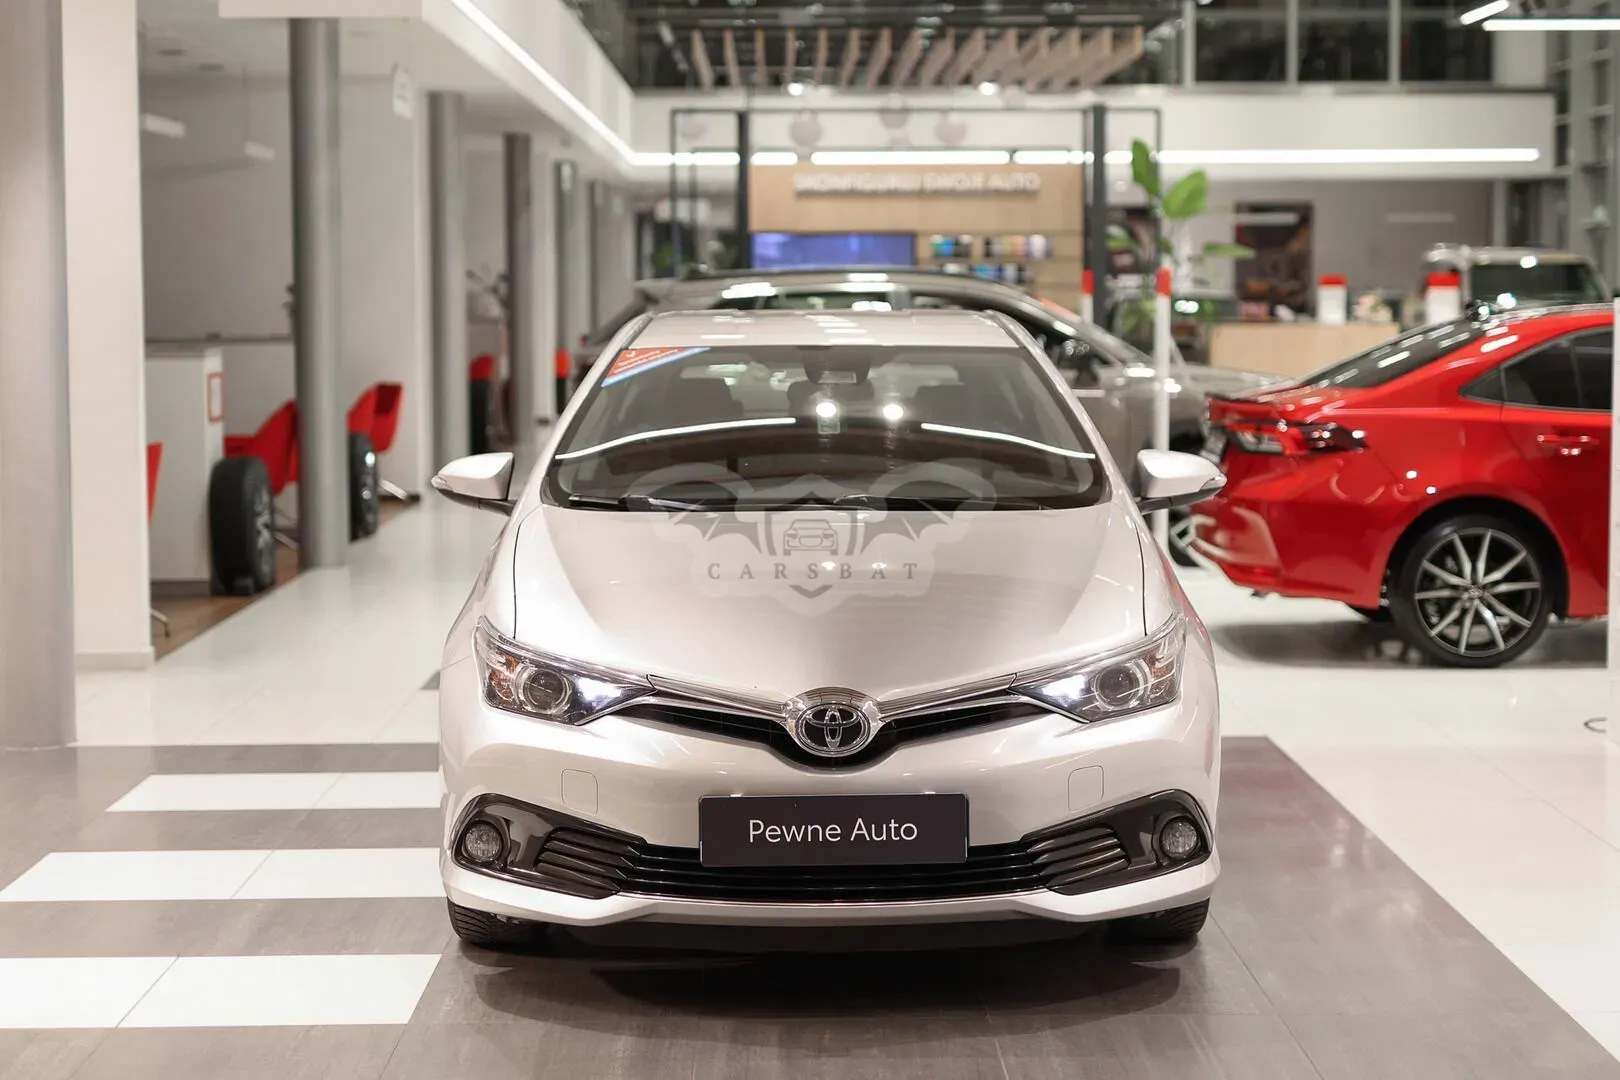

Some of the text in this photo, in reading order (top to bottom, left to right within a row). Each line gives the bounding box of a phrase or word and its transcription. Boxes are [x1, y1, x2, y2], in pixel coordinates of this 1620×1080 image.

[988, 172, 1041, 191] AUTO
[749, 818, 918, 842] Pewne Auto
